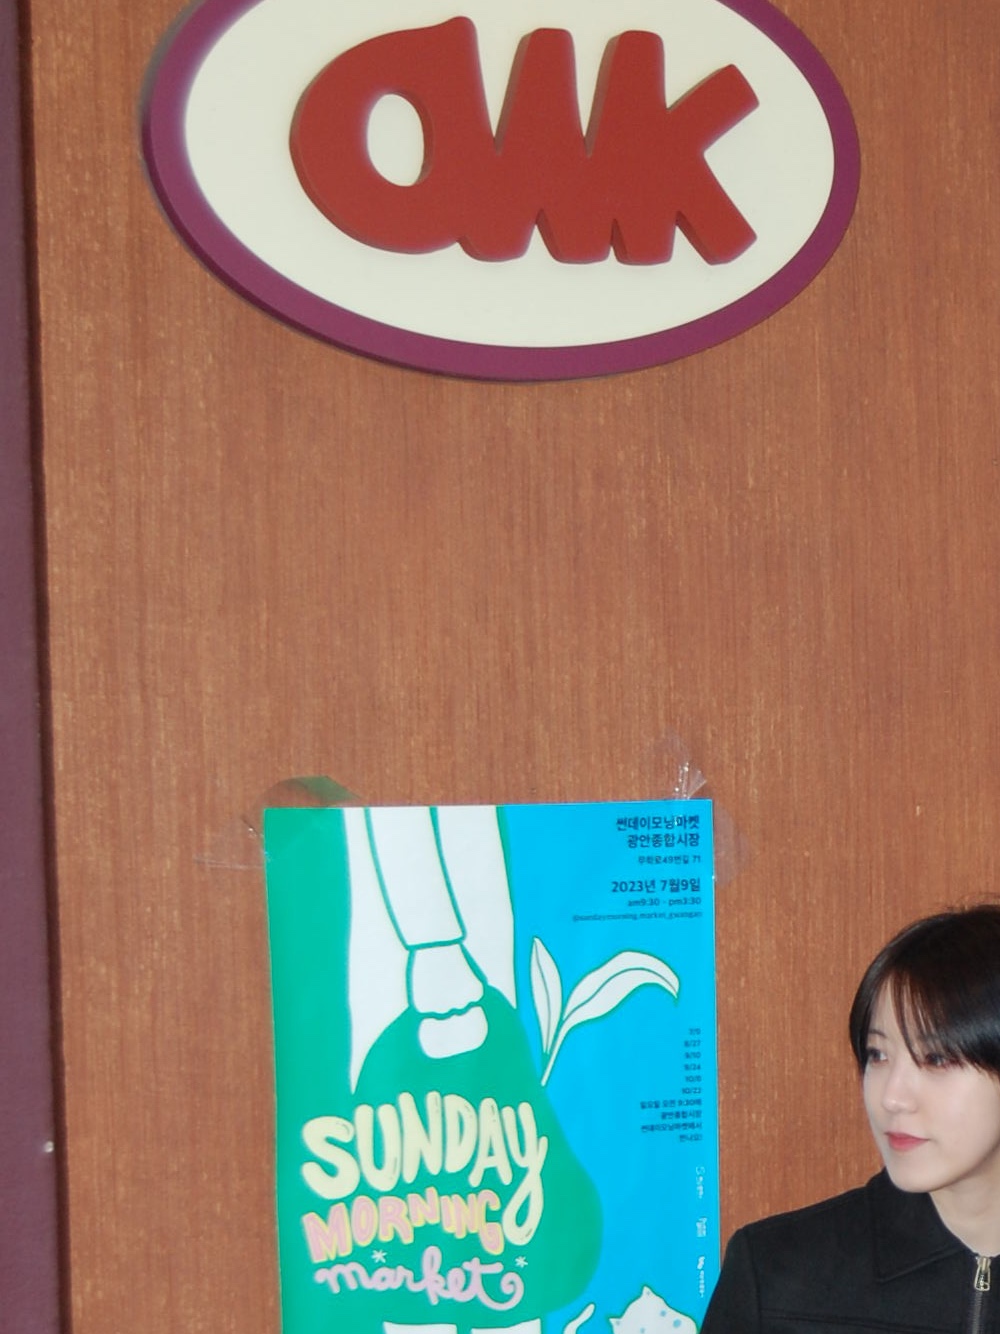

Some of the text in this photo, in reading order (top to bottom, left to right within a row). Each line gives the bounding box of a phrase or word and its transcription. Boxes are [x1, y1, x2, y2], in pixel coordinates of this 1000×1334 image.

[289, 16, 760, 266] OWK
[615, 814, 700, 832] 썬데이모닝마켓
[627, 832, 701, 849] 광안종합시장
[611, 877, 701, 893] 2023년 7월9일
[301, 1090, 549, 1246] SUNDAY
[301, 1186, 505, 1265] MORNING
[313, 1245, 525, 1312] market
